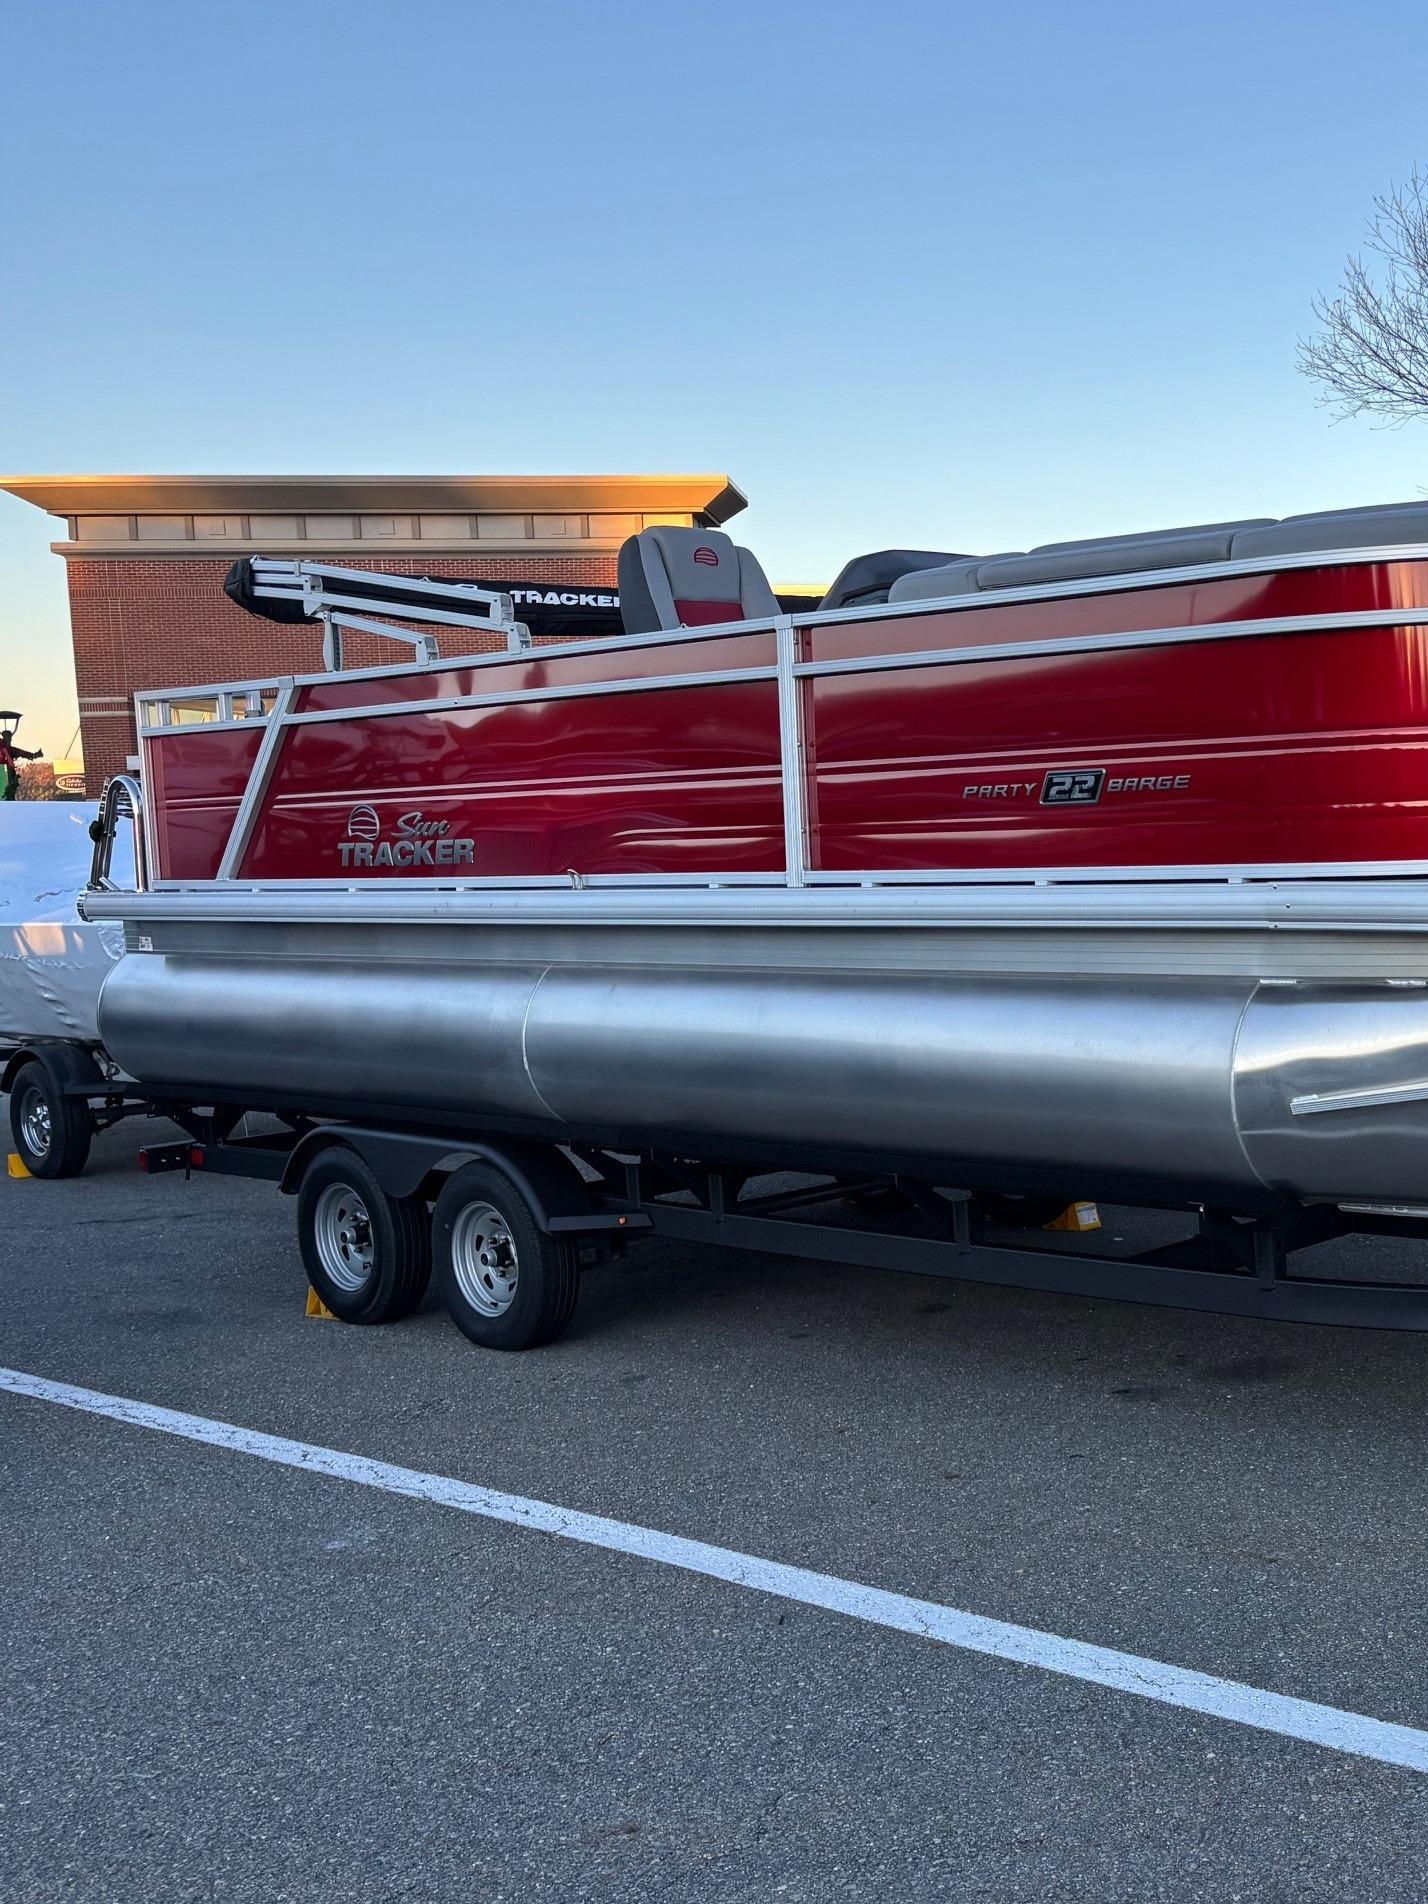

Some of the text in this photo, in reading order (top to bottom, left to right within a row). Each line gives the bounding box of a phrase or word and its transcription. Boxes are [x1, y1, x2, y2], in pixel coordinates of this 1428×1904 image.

[962, 774, 1191, 800] PARTY 22 BARGE
[390, 811, 451, 837] Sun
[337, 838, 475, 867] TRACKER
